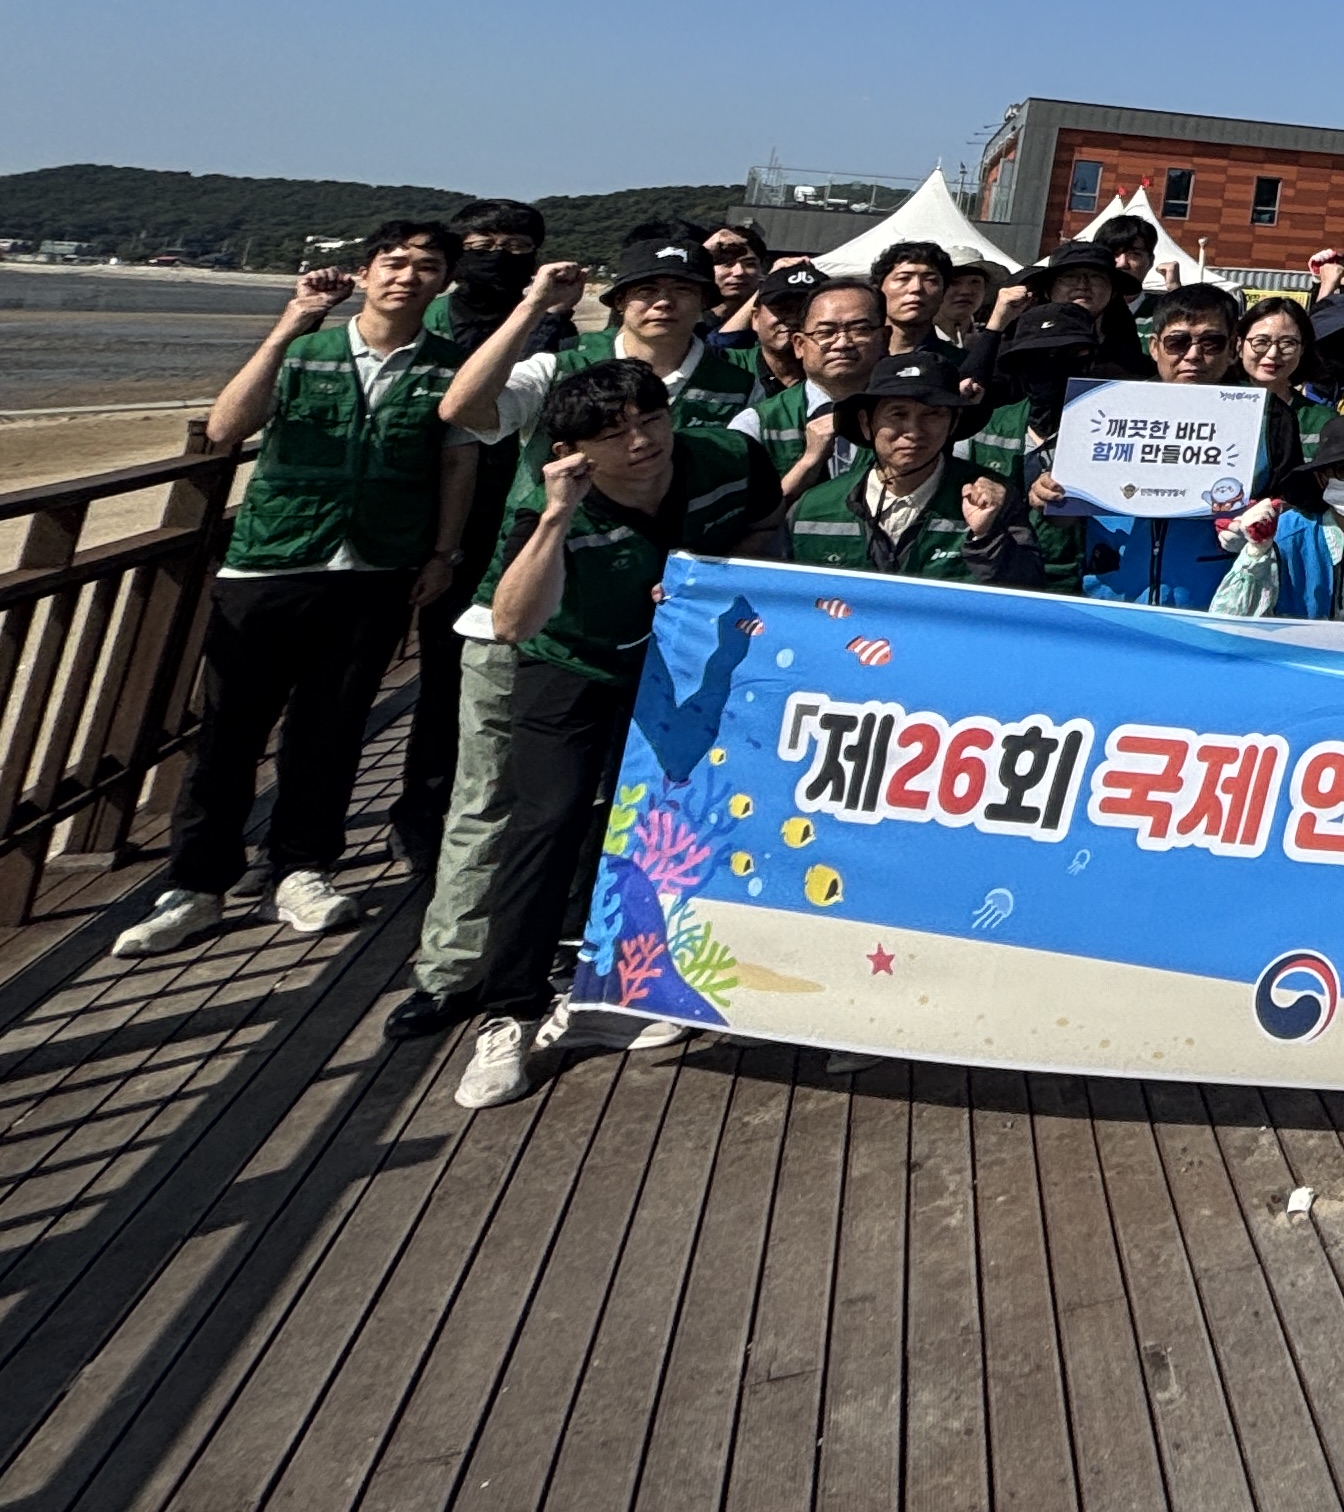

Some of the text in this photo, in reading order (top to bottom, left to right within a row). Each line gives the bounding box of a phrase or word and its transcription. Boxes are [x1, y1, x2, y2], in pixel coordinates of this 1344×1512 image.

[1106, 419, 1216, 441] 깨끗한 바다
[1092, 442, 1222, 465] 함께 만들어요
[788, 703, 1082, 829] 「제26회
[1099, 735, 1278, 845] 국제
